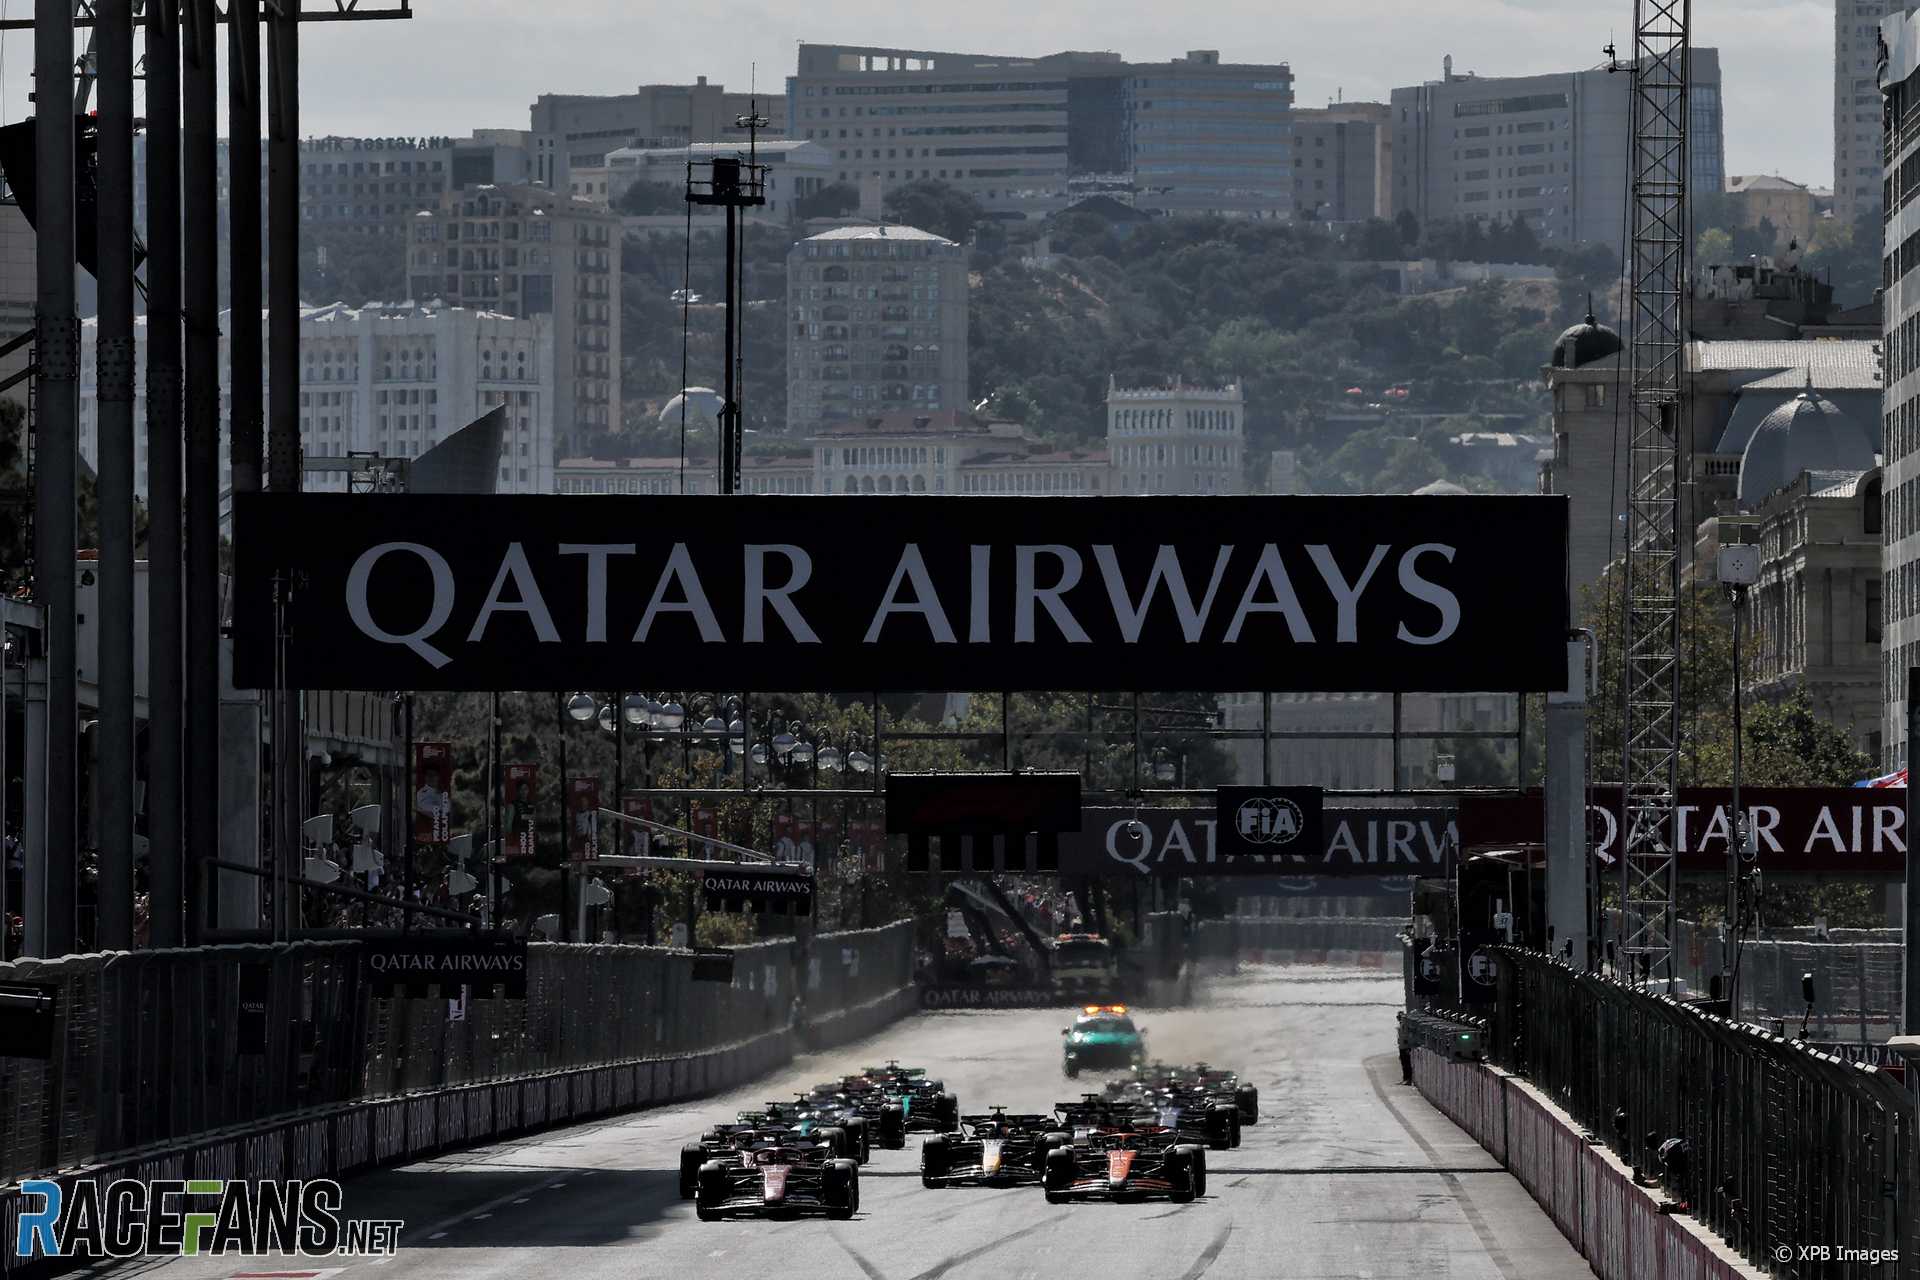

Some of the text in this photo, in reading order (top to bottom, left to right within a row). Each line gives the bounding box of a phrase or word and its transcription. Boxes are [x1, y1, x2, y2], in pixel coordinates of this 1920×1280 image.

[345, 541, 1462, 669] QATAR AIRWAYS
[1803, 805, 1908, 853] AIR
[704, 878, 811, 894] QATAR AIRWAYS
[370, 953, 523, 973] QATAR AIRWAYS
[926, 989, 1052, 1005] QATAR AIRWAYS
